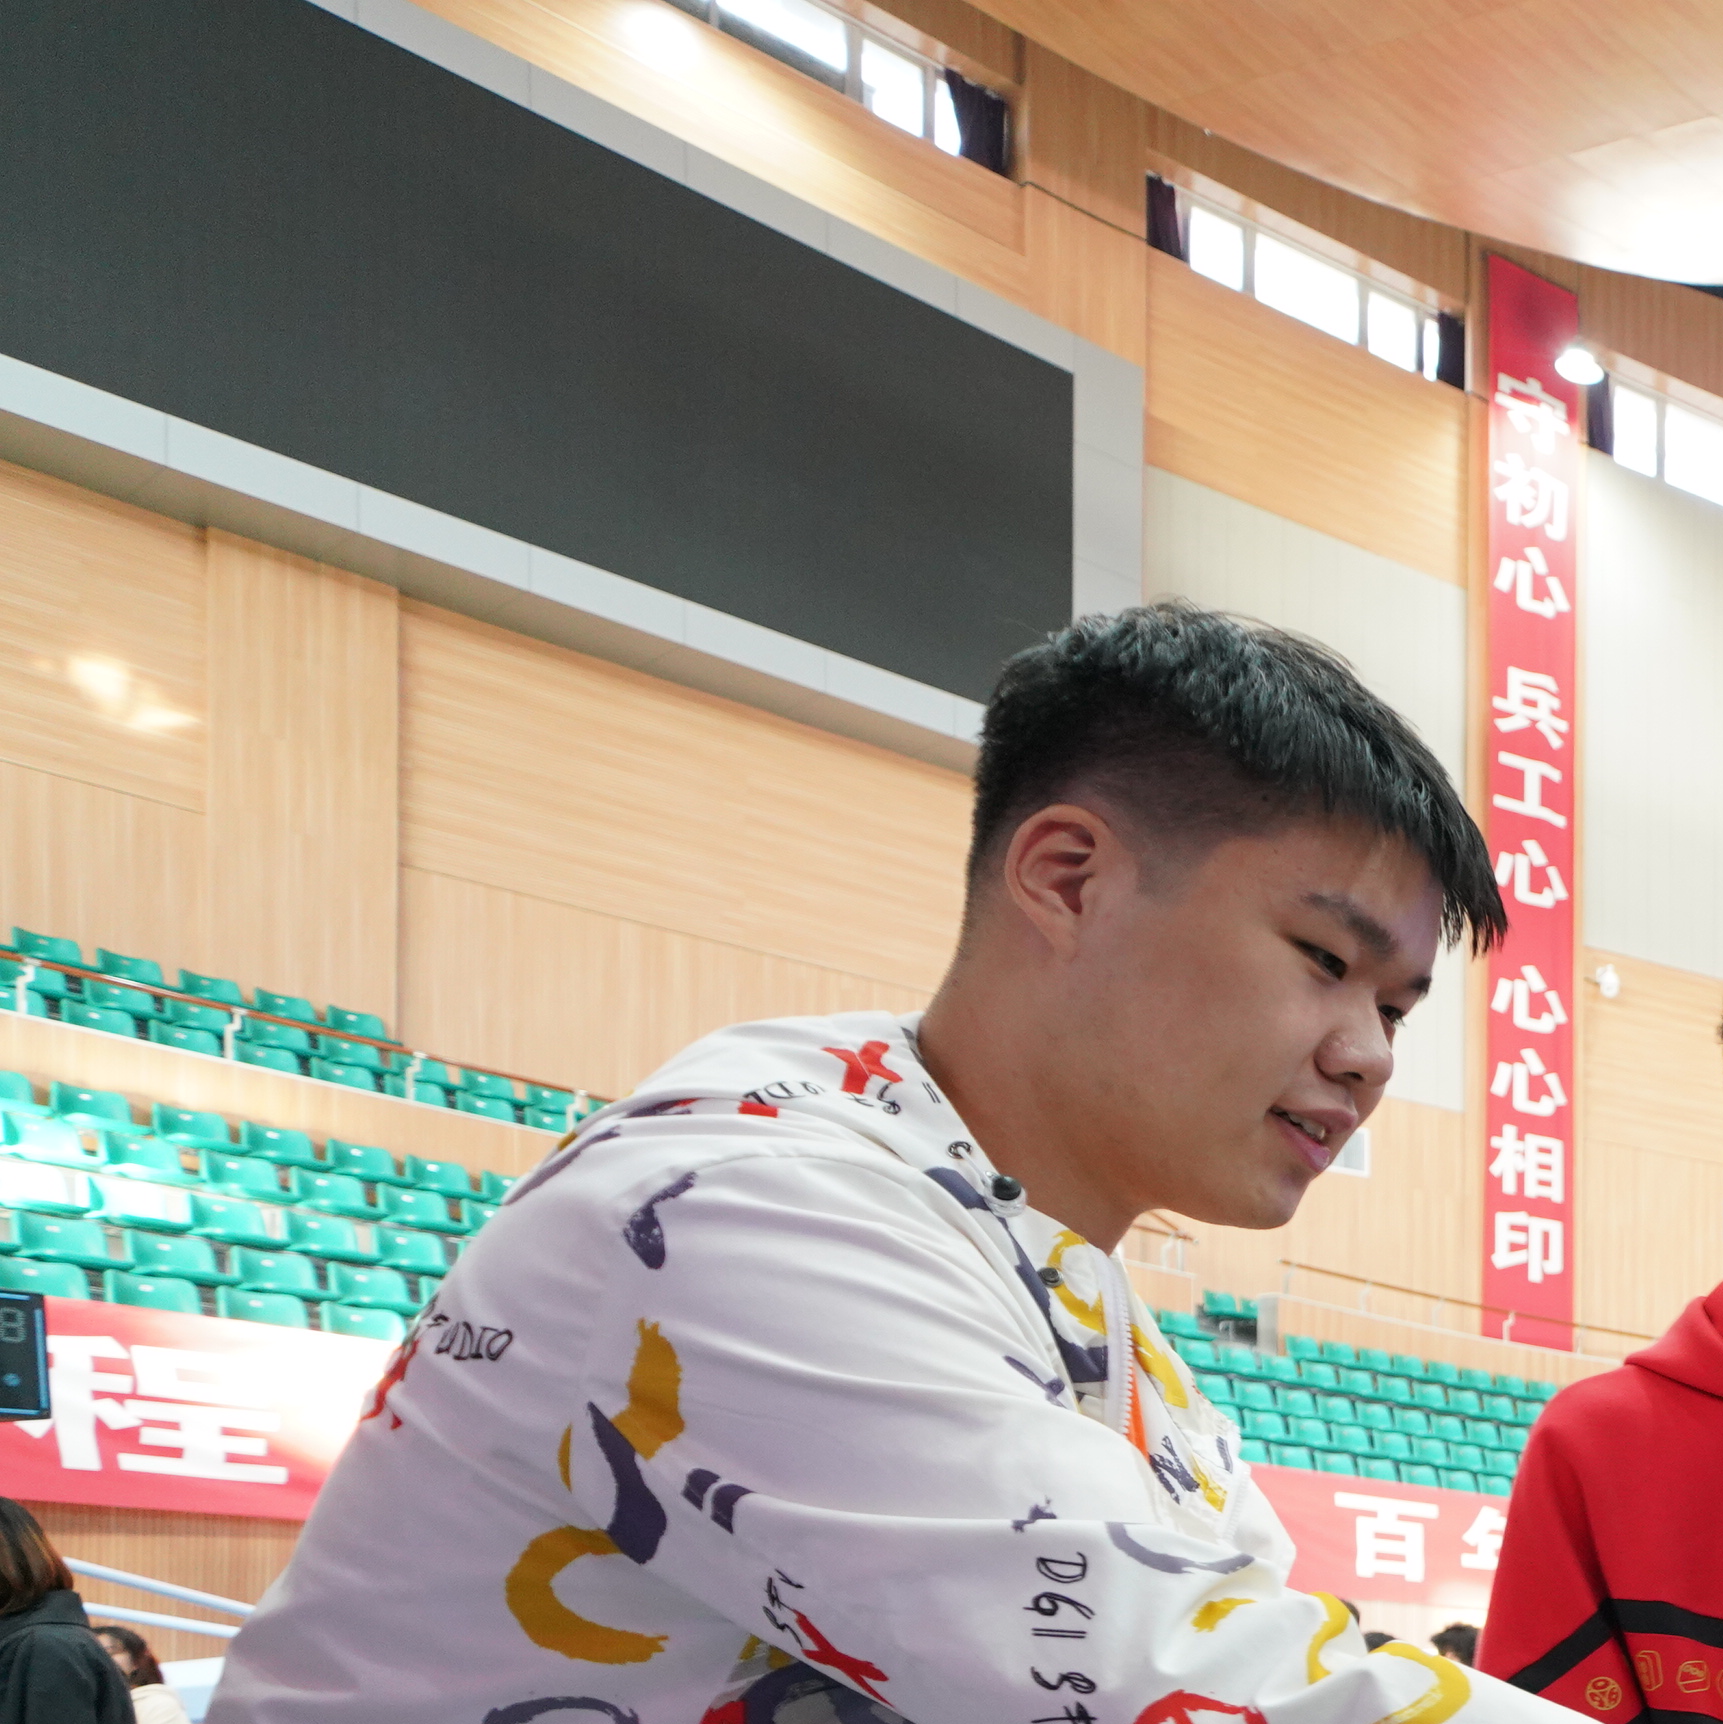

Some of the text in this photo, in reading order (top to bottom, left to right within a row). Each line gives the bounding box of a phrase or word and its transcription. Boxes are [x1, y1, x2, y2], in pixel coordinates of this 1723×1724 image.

[1491, 665, 1570, 910] 兵工心
[1489, 964, 1569, 1284] 心心相印
